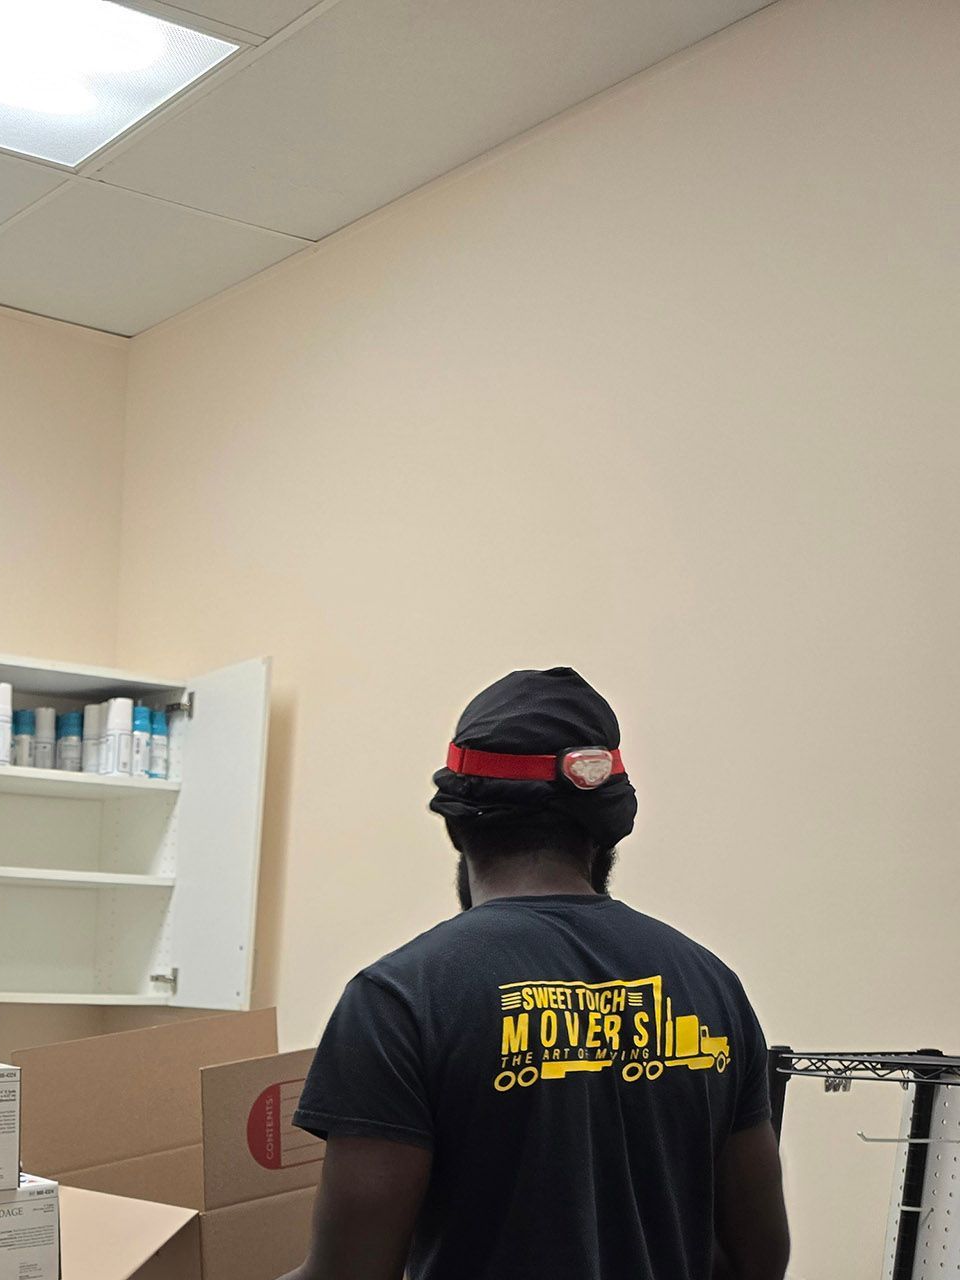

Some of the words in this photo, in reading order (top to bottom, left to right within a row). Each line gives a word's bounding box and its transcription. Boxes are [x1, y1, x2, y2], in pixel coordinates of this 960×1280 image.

[520, 987, 572, 1010] SWEET
[501, 1010, 649, 1056] MOVERS
[500, 1051, 533, 1069] THE
[542, 1049, 571, 1060] ART
[595, 1047, 650, 1061] MVING
[265, 1097, 274, 1160] CONTENTS
